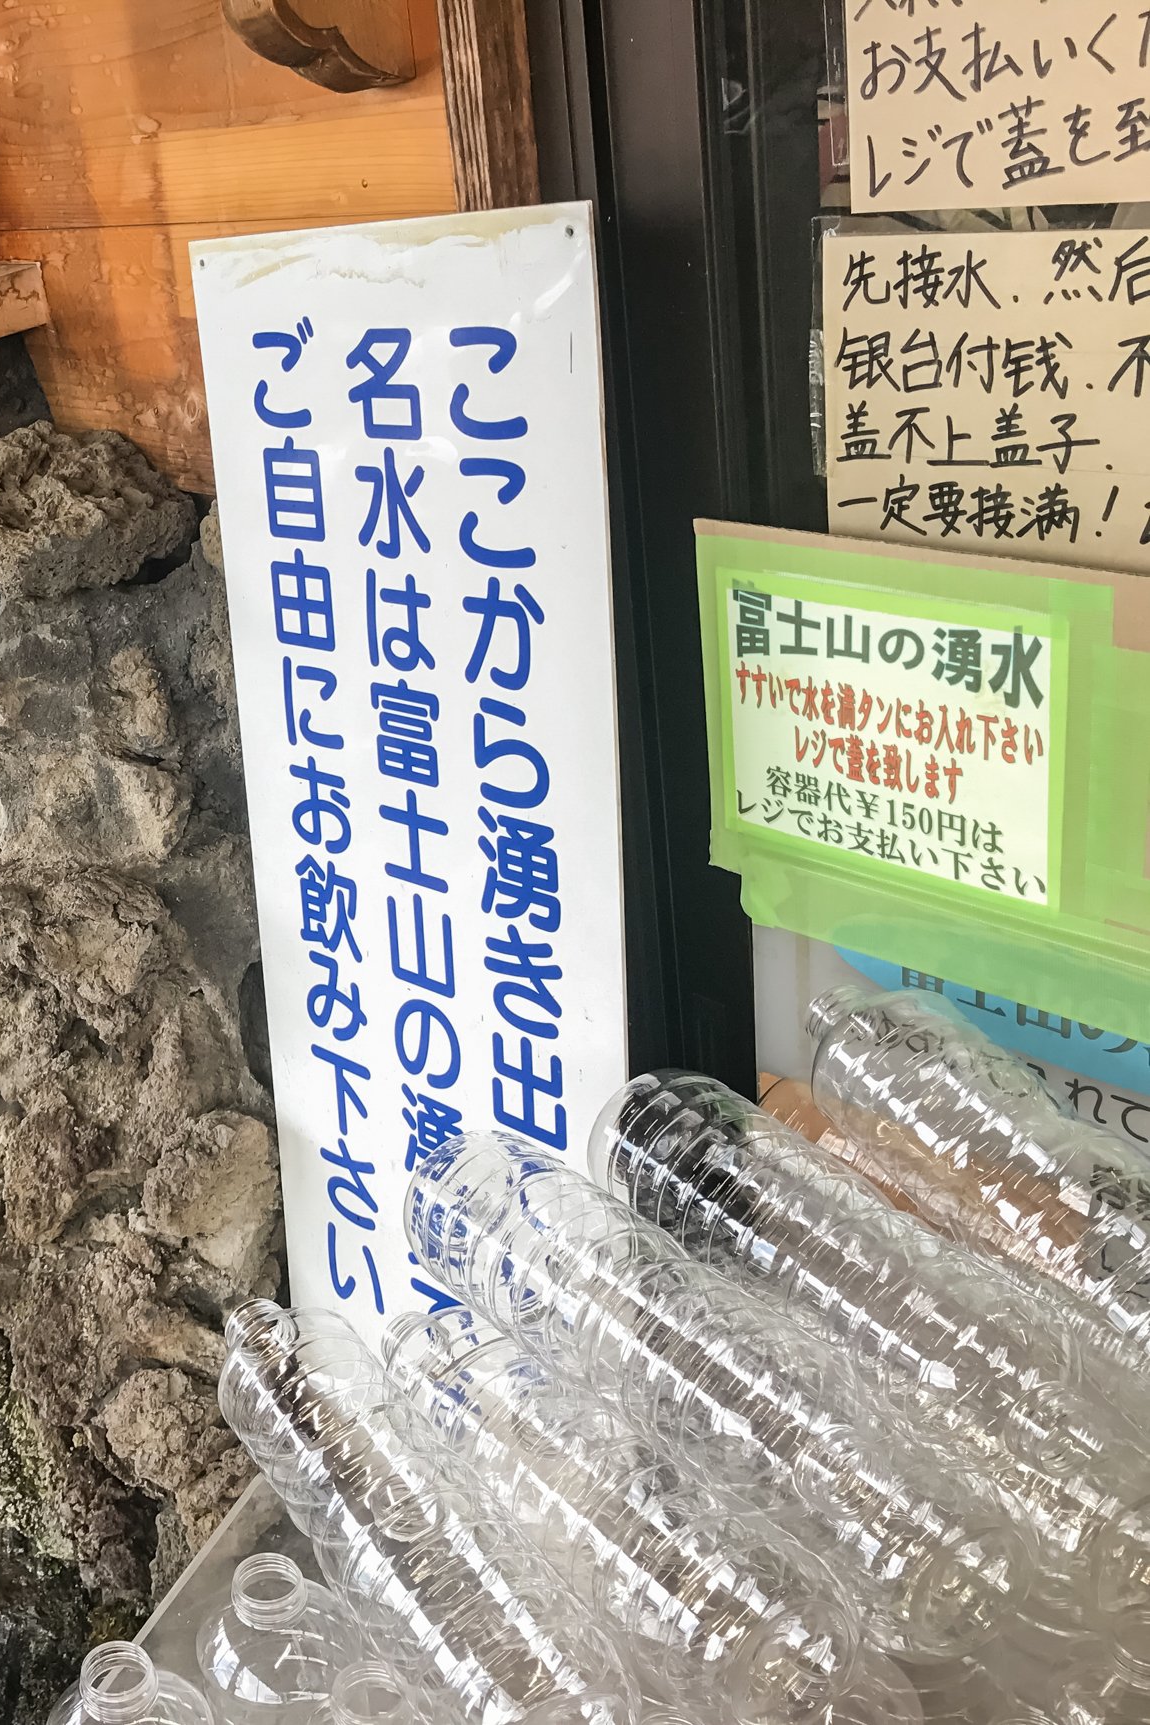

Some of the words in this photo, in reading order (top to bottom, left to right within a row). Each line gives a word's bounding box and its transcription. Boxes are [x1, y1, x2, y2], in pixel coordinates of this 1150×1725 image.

[731, 578, 1045, 710] 富士山の湧水
[736, 662, 1044, 765] すすいで水を満タンにお入れ下さい
[794, 726, 963, 804] レジで蓋を致します
[253, 316, 384, 1314] ご自由にお飲み下さい
[736, 789, 1047, 897] レジでお支払い下さい
